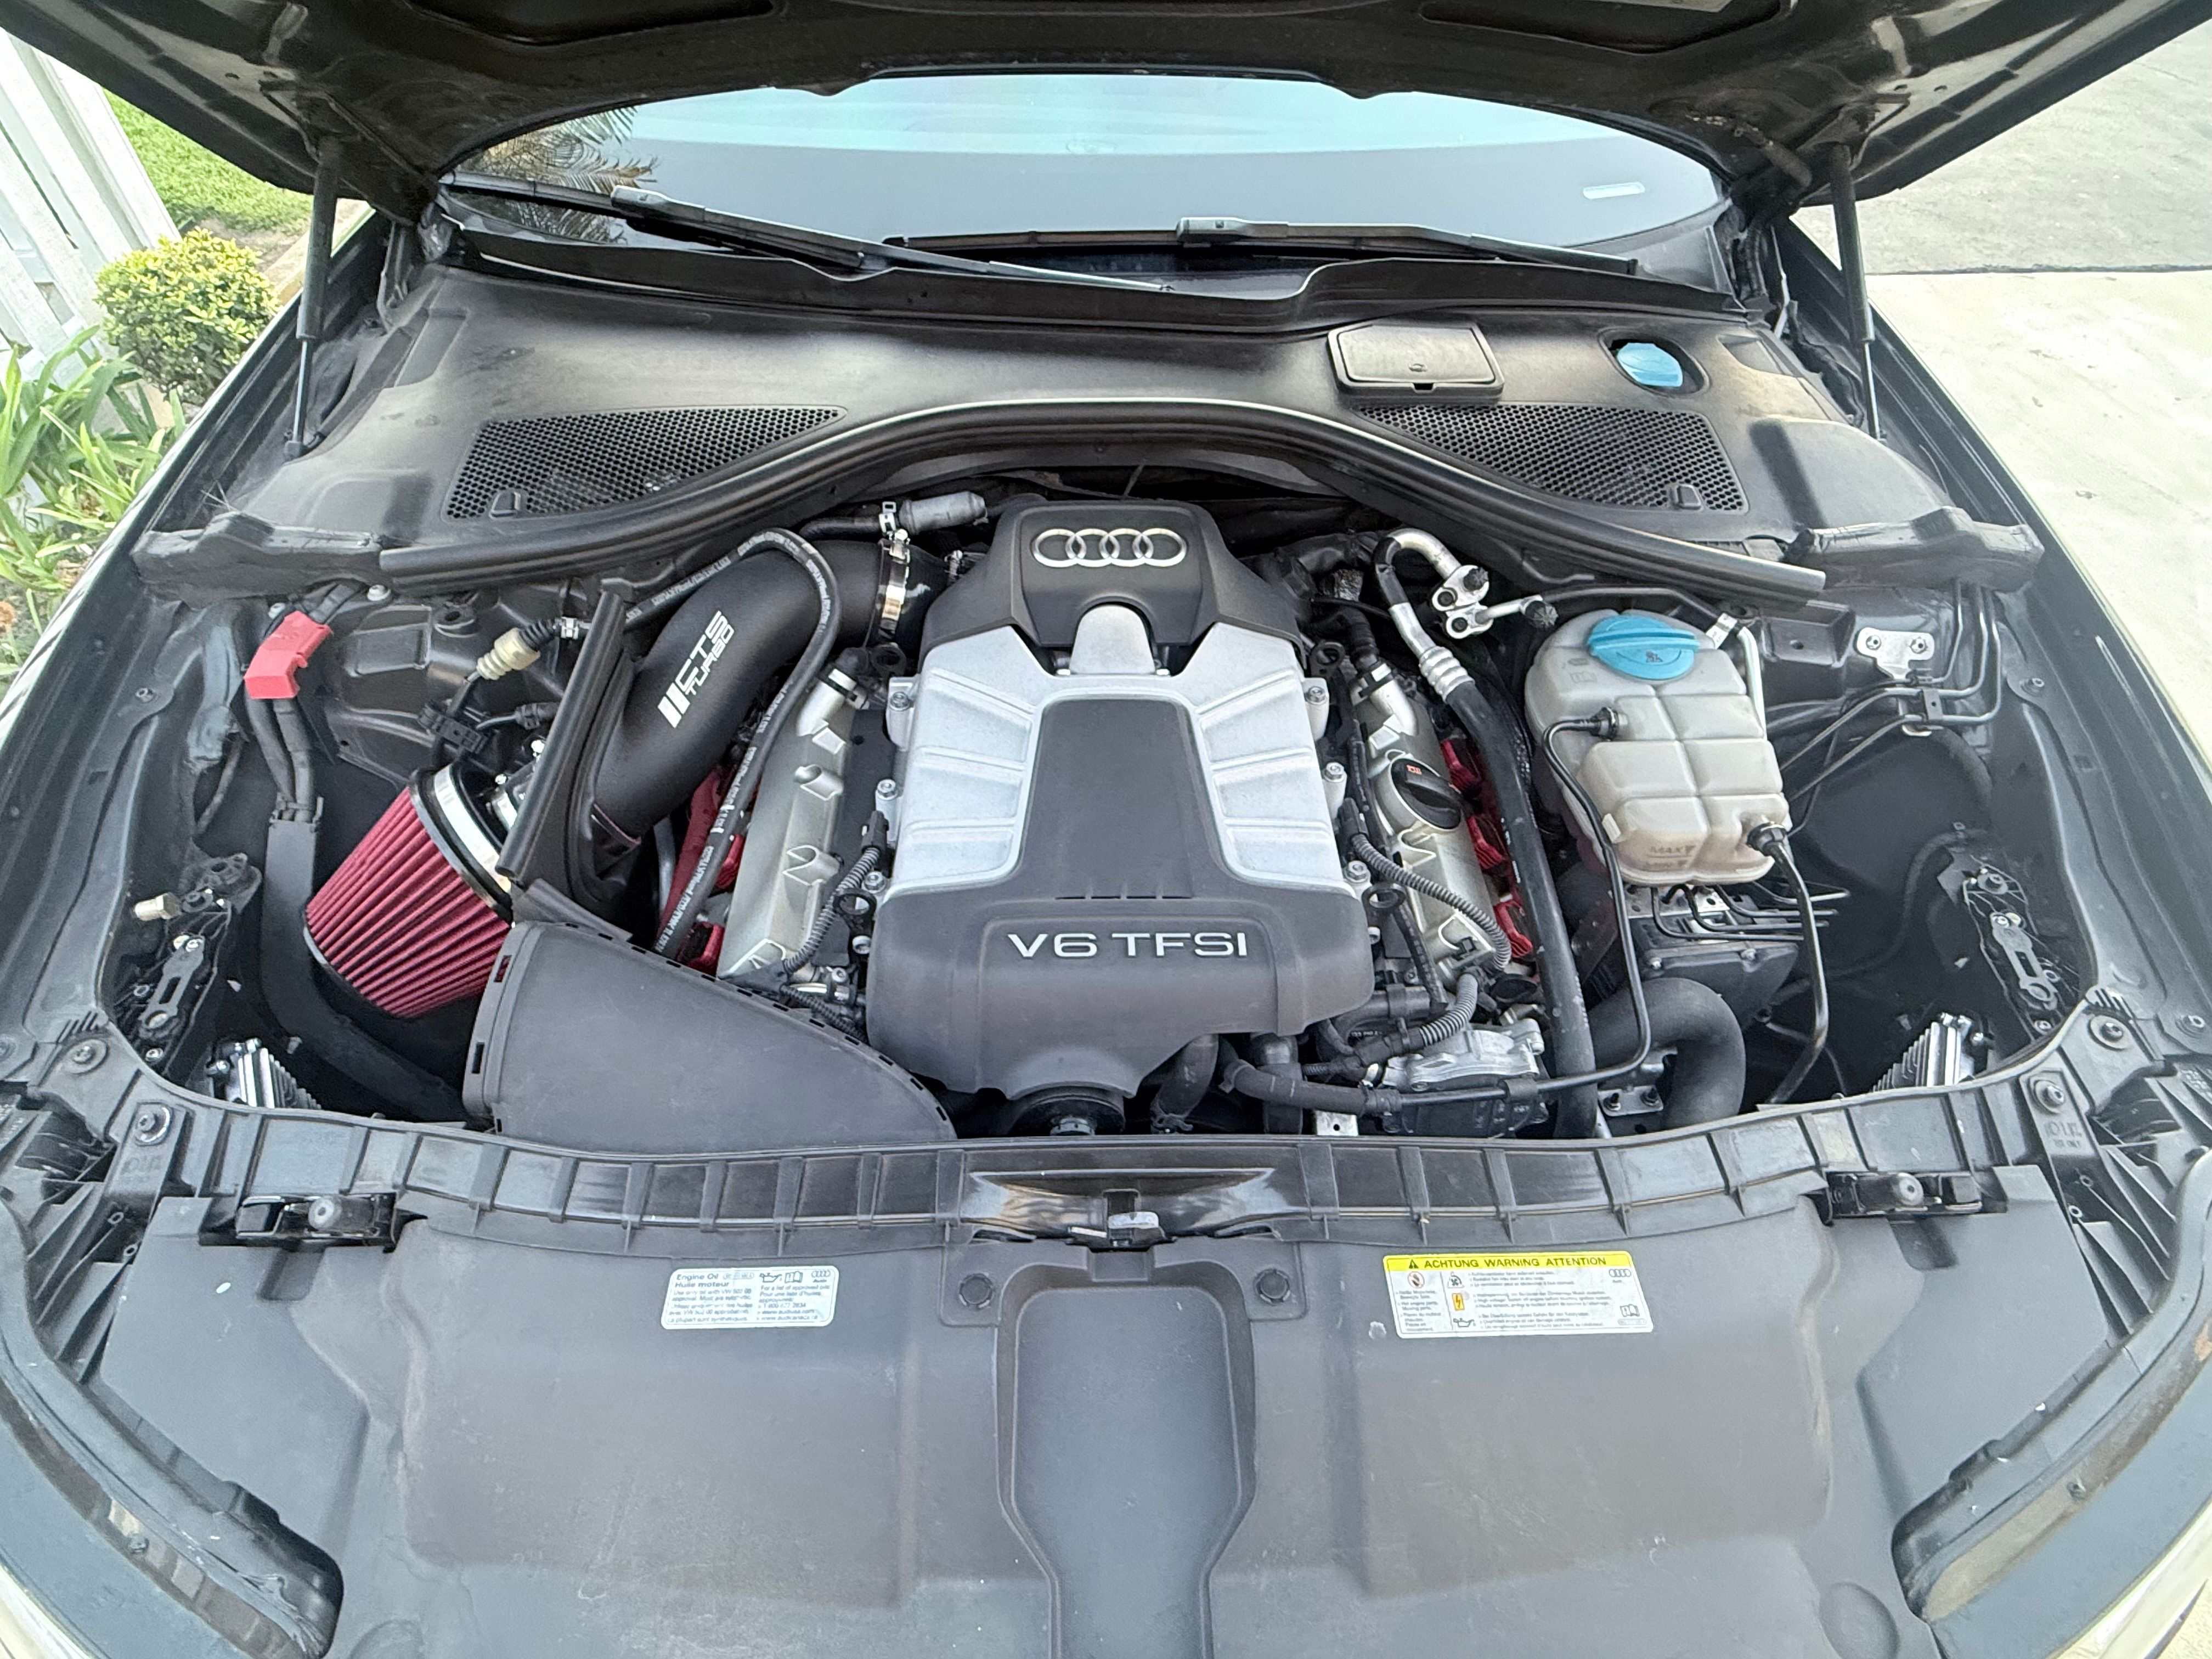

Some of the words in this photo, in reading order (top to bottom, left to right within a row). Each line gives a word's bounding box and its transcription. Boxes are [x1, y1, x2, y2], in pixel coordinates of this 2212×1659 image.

[675, 610, 728, 692] CTS
[685, 624, 735, 695] TURBO
[1007, 932, 1097, 957] V6
[1111, 932, 1248, 957] TFSI
[1424, 1259, 1479, 1268] ACHTUNG
[1484, 1258, 1540, 1267] WARNING
[1546, 1257, 1606, 1266] ATTENTION
